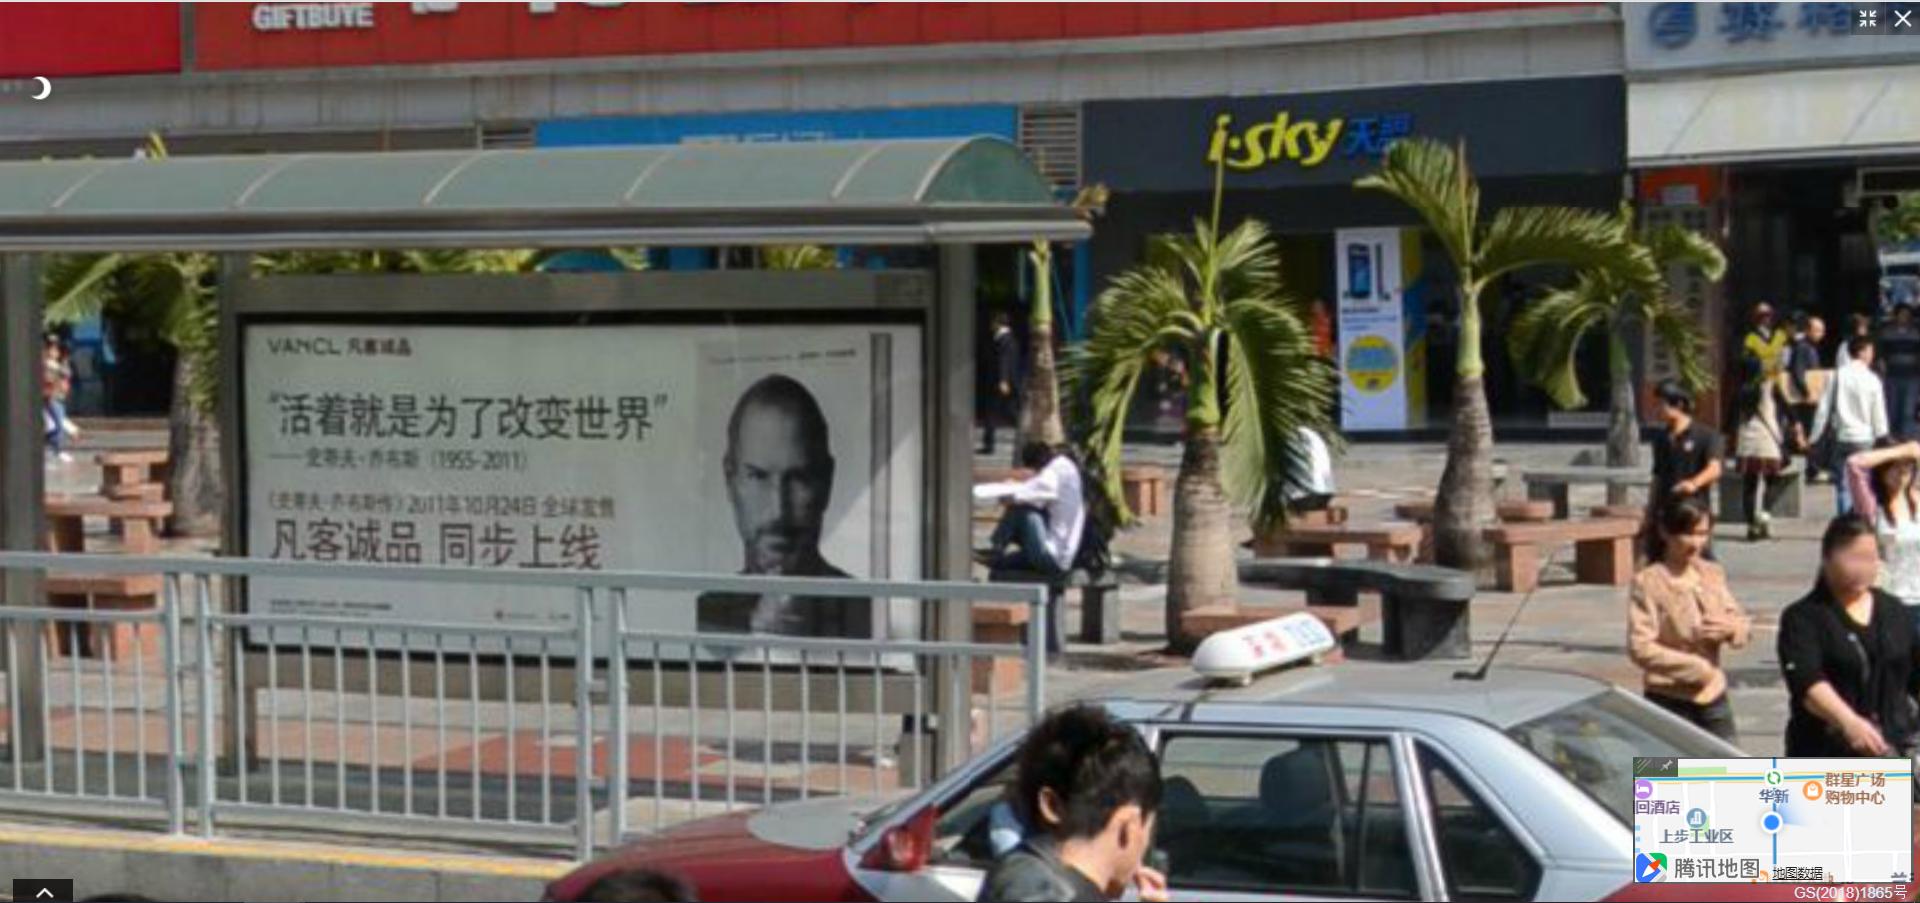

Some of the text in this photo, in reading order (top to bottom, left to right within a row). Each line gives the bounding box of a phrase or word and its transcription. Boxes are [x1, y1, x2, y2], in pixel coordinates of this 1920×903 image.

[267, 337, 342, 356] VANCL
[269, 517, 602, 570] 凡客诚品 同步上线
